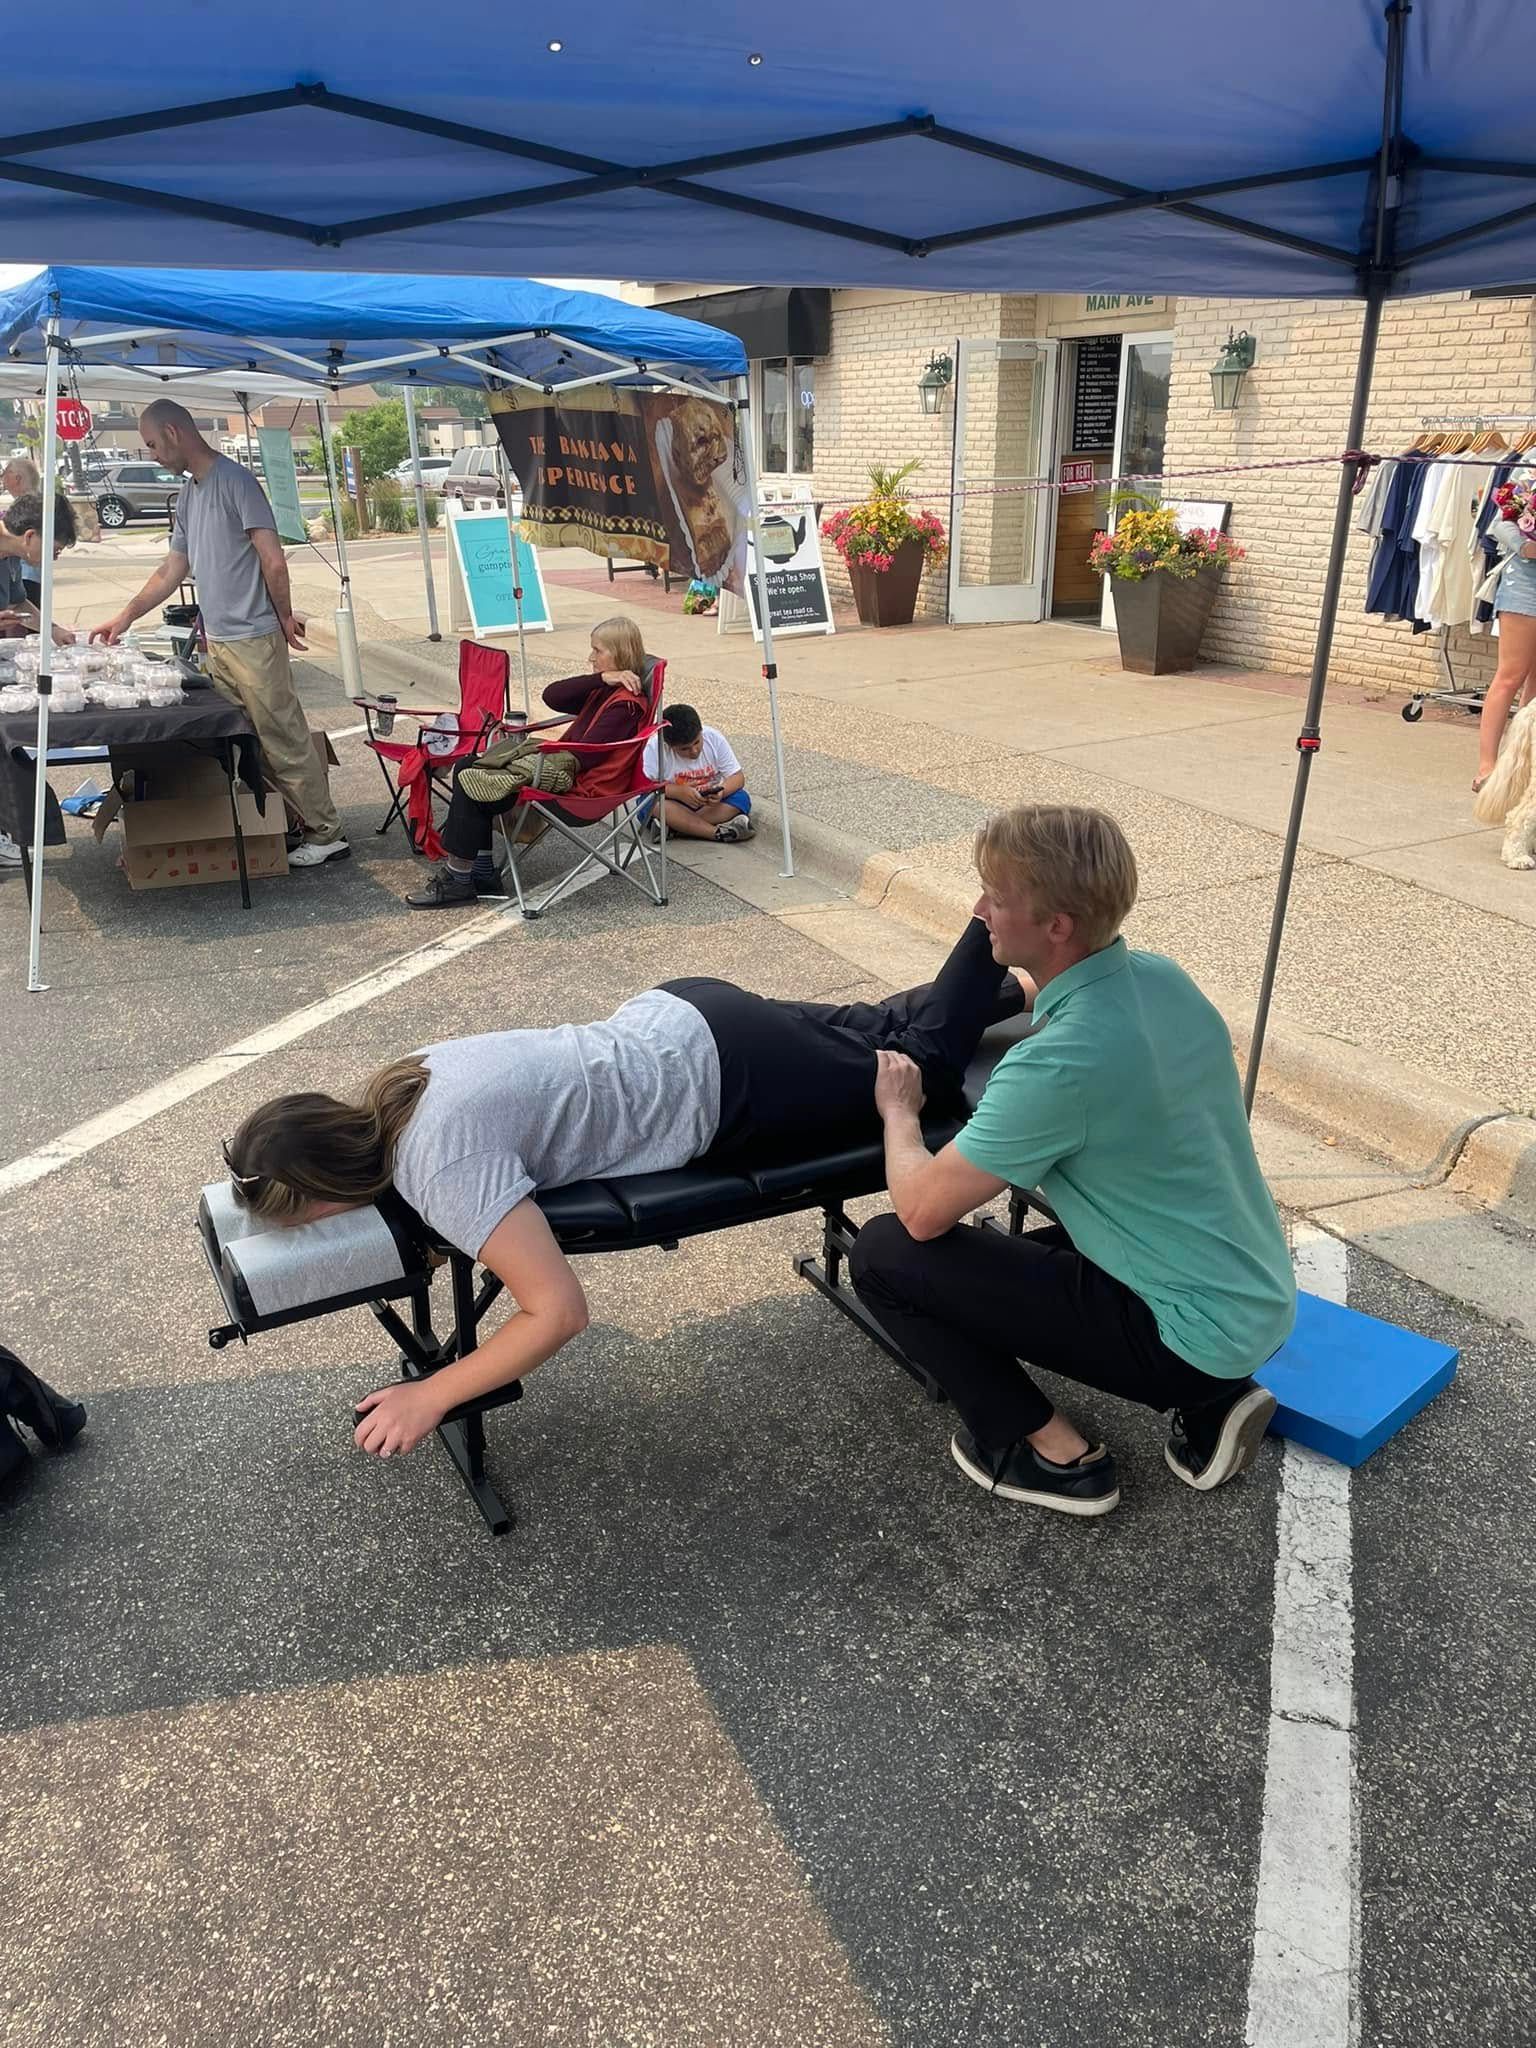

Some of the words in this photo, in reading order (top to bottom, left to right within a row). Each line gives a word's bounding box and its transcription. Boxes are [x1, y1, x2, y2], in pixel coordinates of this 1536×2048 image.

[1086, 294, 1120, 312] MAIN
[1126, 294, 1154, 307] AVE
[560, 435, 637, 463] BAKLAVA
[537, 465, 637, 495] PERIENCE
[1063, 466, 1074, 482] FOR
[1075, 464, 1091, 480] RENT
[753, 575, 785, 585] Scialty
[786, 573, 798, 582] Tea
[799, 572, 817, 582] Shop
[495, 592, 514, 602] OPE
[787, 586, 807, 595] open.
